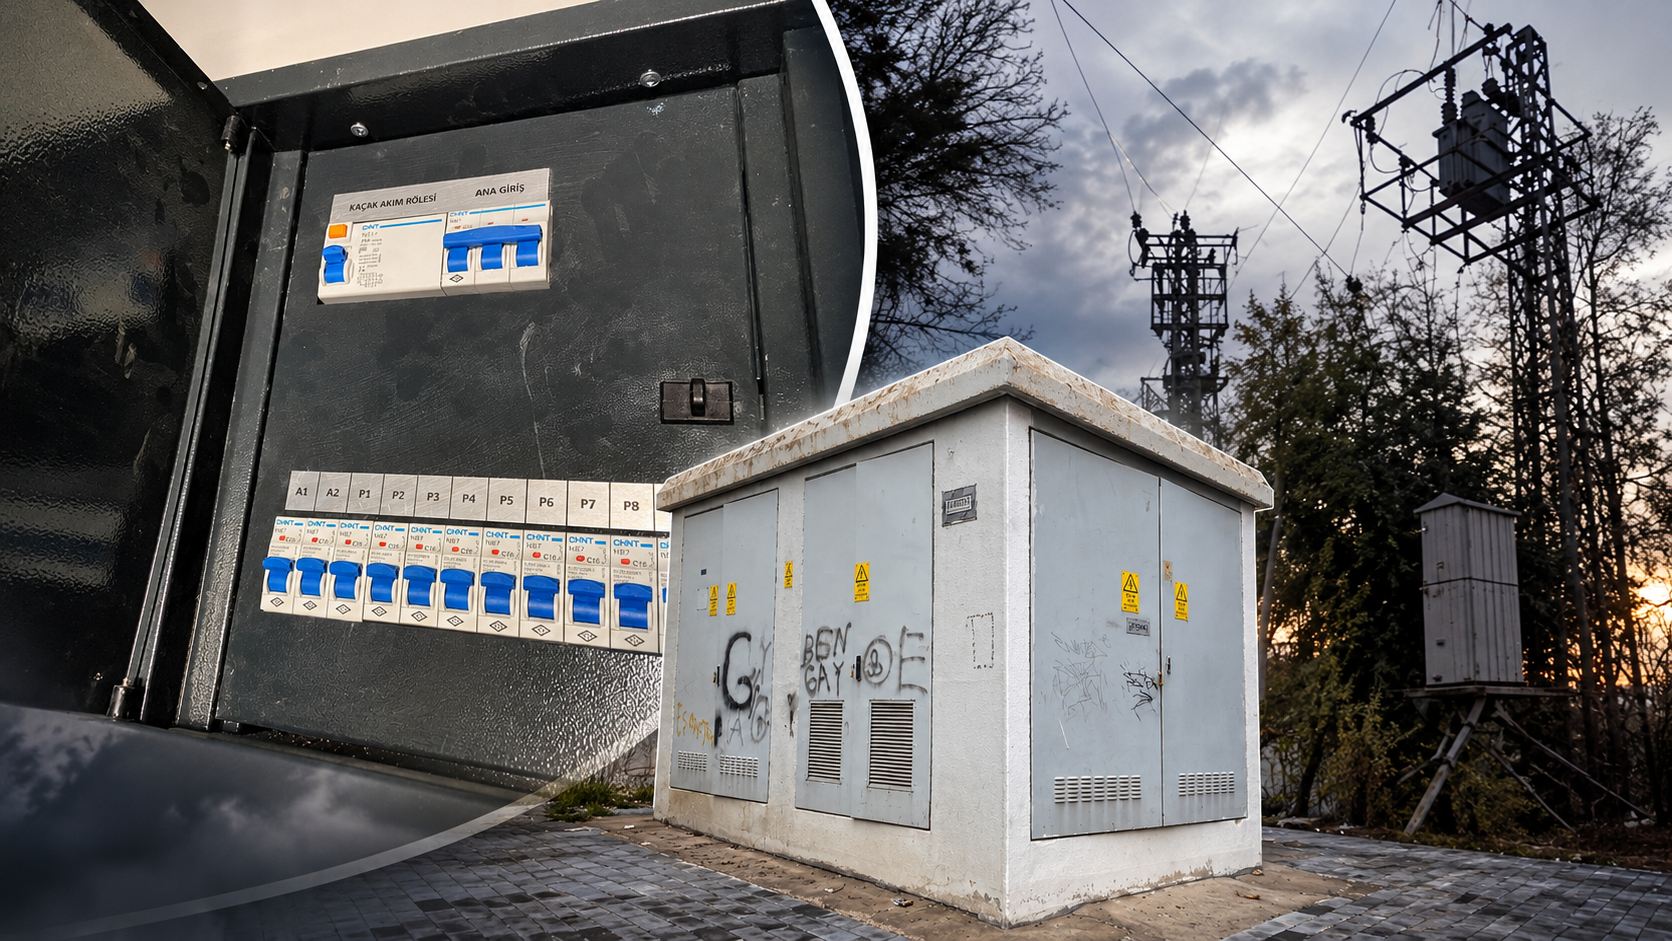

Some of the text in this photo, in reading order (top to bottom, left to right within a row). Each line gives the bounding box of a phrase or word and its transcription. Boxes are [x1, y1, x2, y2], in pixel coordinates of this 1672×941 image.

[475, 183, 525, 197] ANA GİRİŞ
[349, 193, 437, 212] KAÇAK AKIM RÖLESİ
[295, 487, 308, 497] A1
[326, 488, 340, 498] A2
[359, 490, 371, 499] P1
[392, 491, 405, 500] P2
[427, 492, 440, 502] P3
[462, 494, 476, 504] P4
[500, 495, 514, 505] P5
[539, 497, 554, 507] P6
[580, 499, 596, 509] P7
[623, 501, 640, 512] P8
